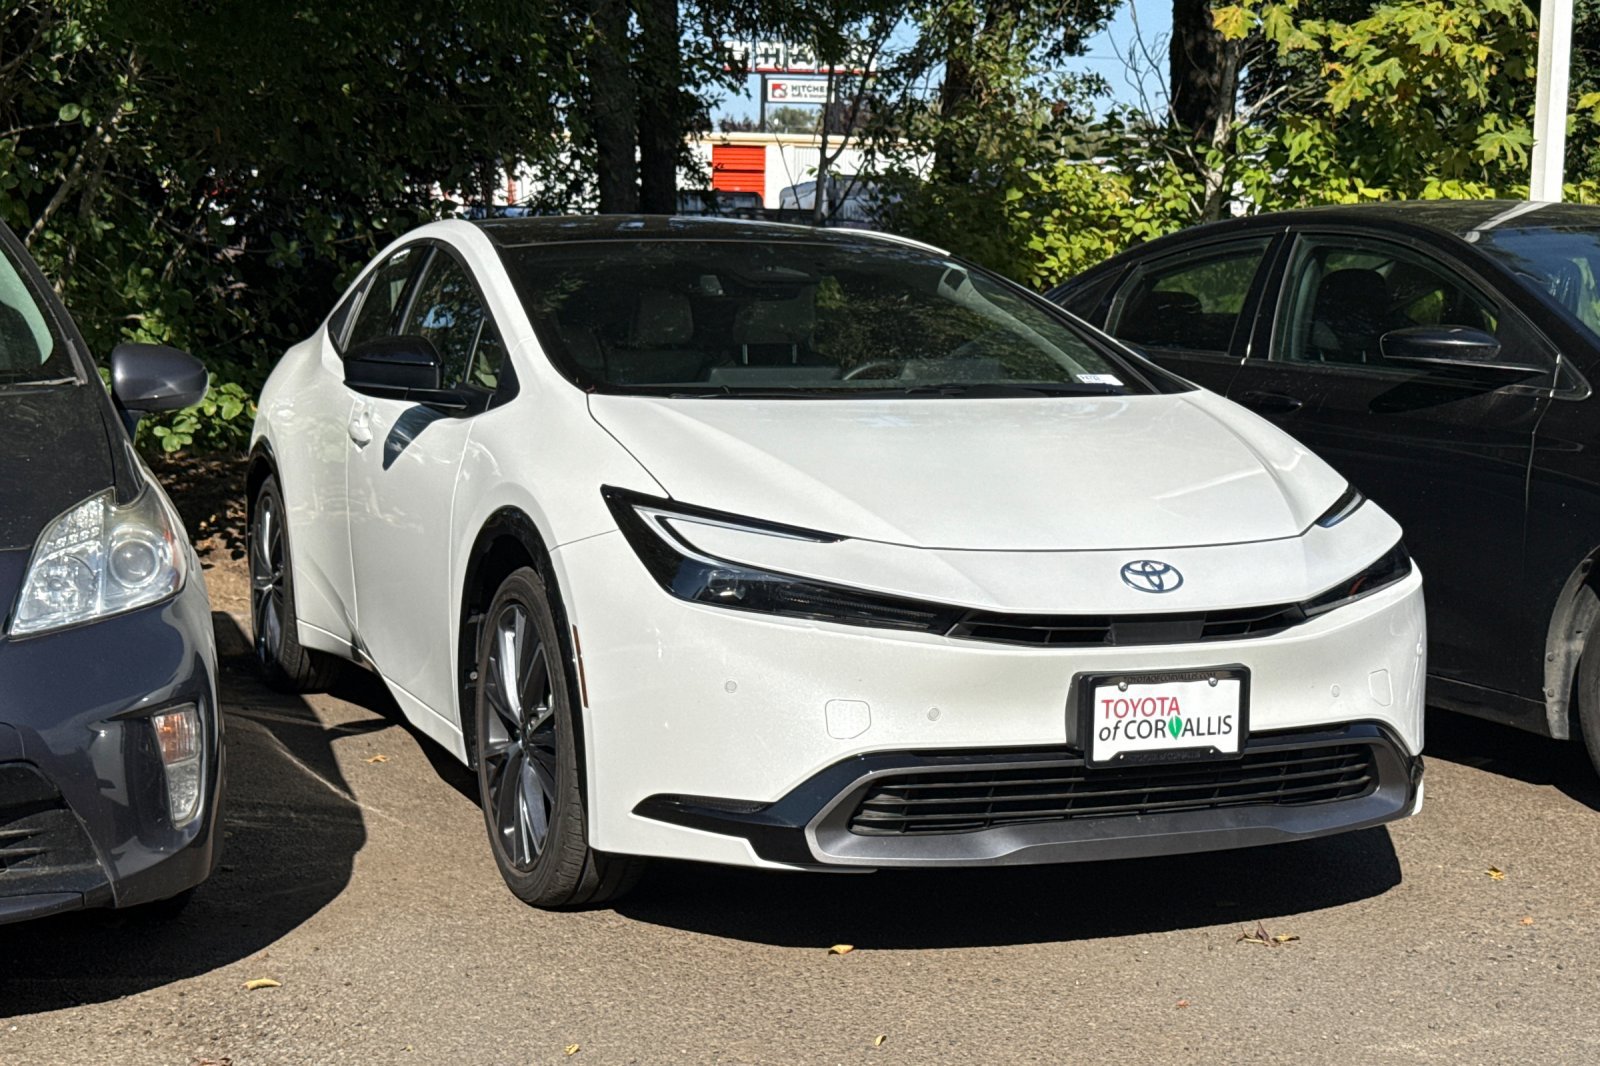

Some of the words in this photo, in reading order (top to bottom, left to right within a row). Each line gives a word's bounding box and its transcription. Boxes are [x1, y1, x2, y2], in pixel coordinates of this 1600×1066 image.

[1101, 696, 1181, 719] TOYOTA
[1099, 720, 1122, 741] of
[1124, 715, 1232, 740] CORVALLIS
